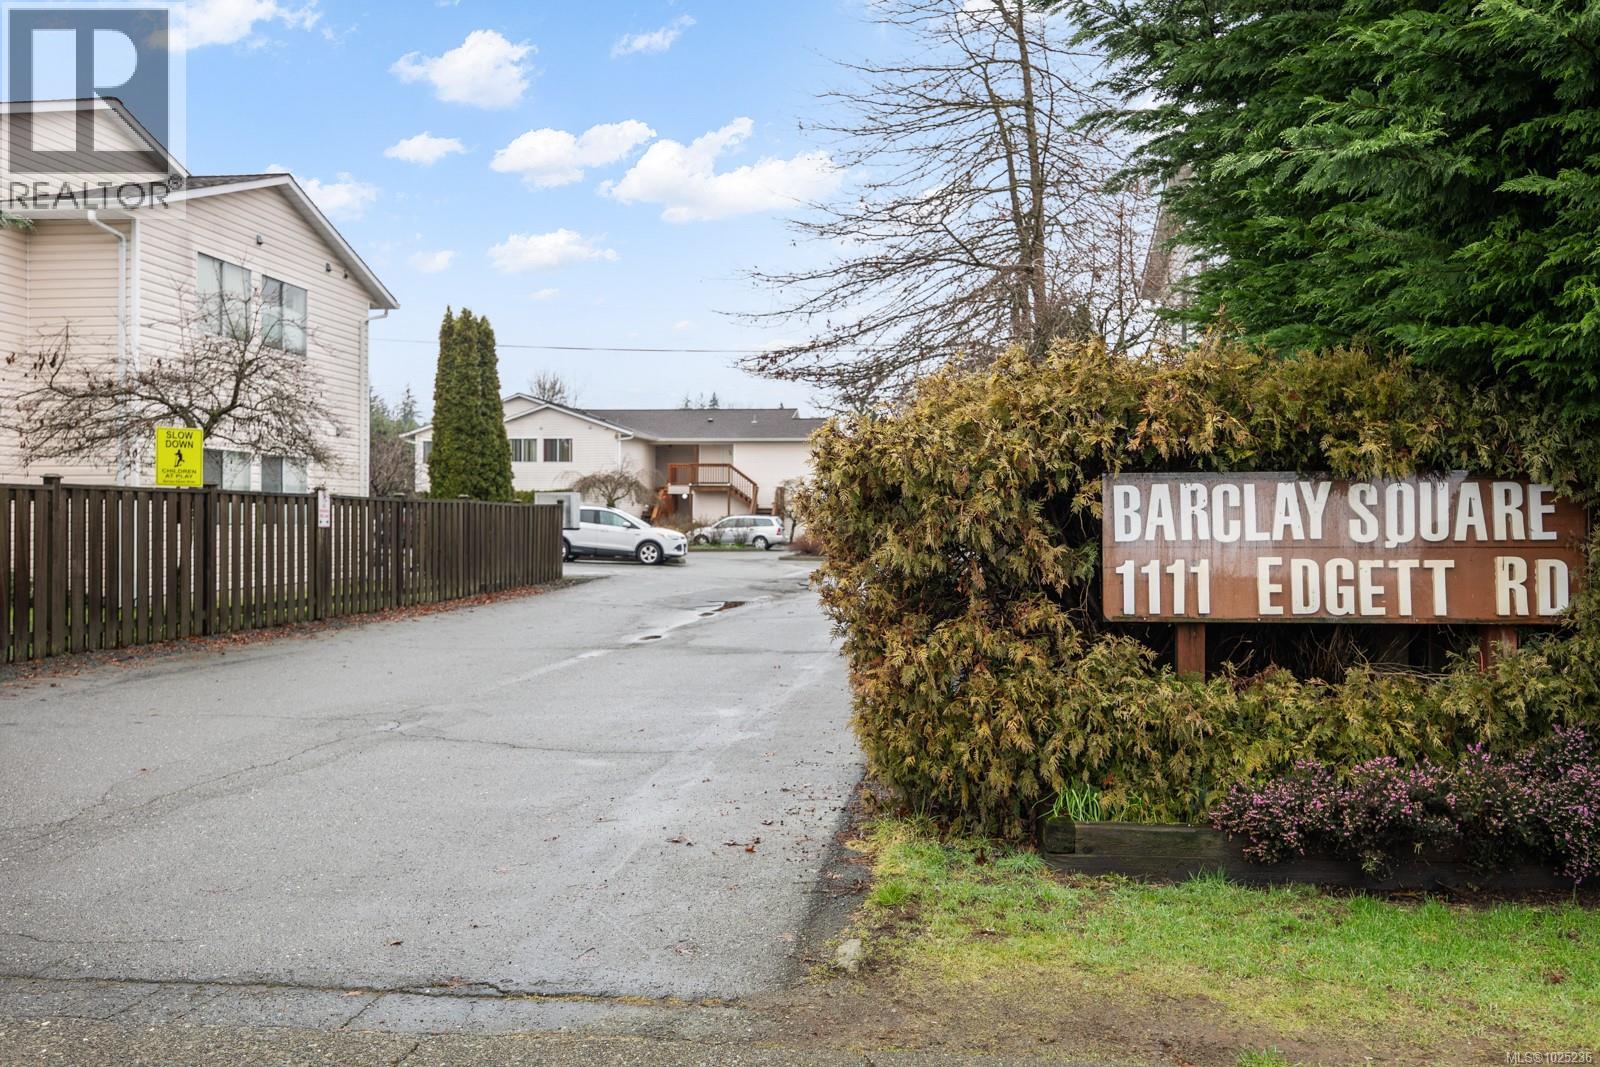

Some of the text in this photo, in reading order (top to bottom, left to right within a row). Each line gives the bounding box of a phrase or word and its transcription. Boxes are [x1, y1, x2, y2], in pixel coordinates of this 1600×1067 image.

[165, 440, 193, 448] DOWN
[166, 431, 193, 439] SLOW
[1113, 481, 1558, 549] BARCLAY SQUARE
[1115, 556, 1569, 616] 1111 EDGETT RD
